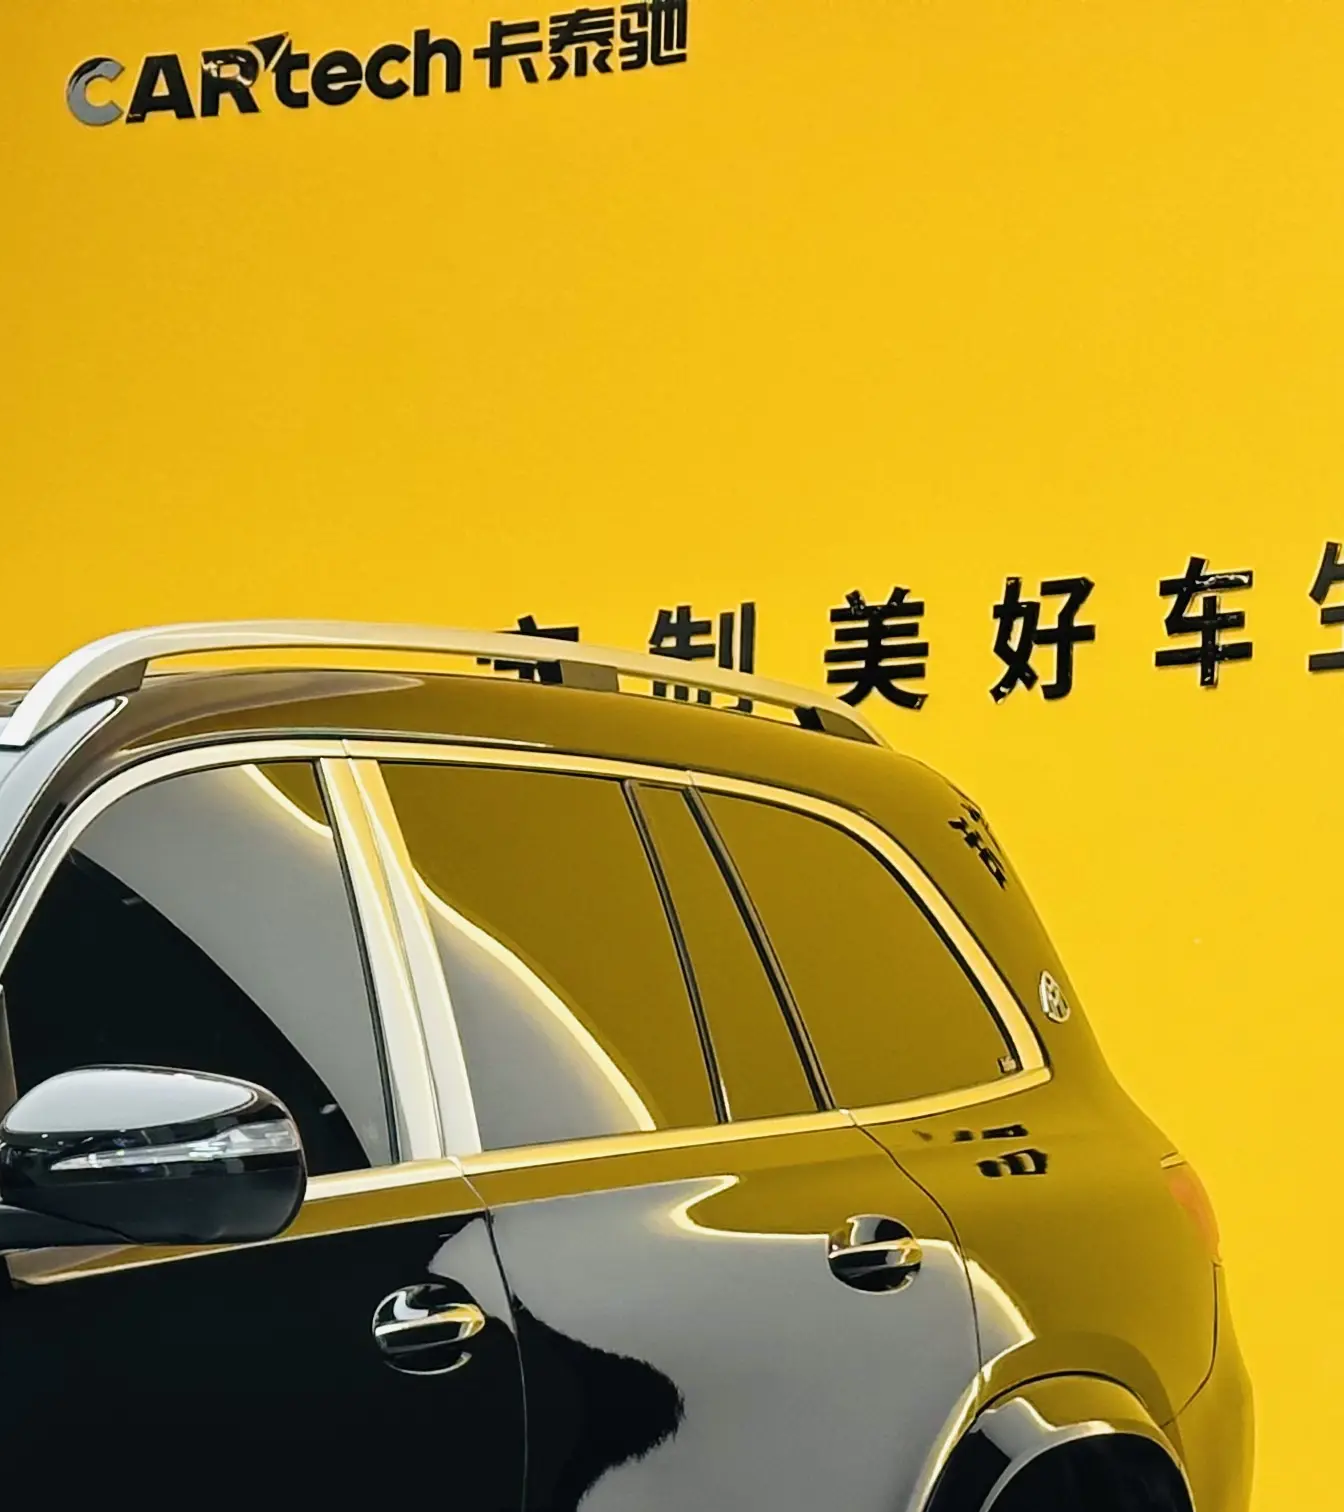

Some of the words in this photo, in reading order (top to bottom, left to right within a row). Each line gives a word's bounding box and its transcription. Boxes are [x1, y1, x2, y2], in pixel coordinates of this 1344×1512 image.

[65, 27, 462, 126] CARtech
[473, 0, 688, 88] 卡泰驰
